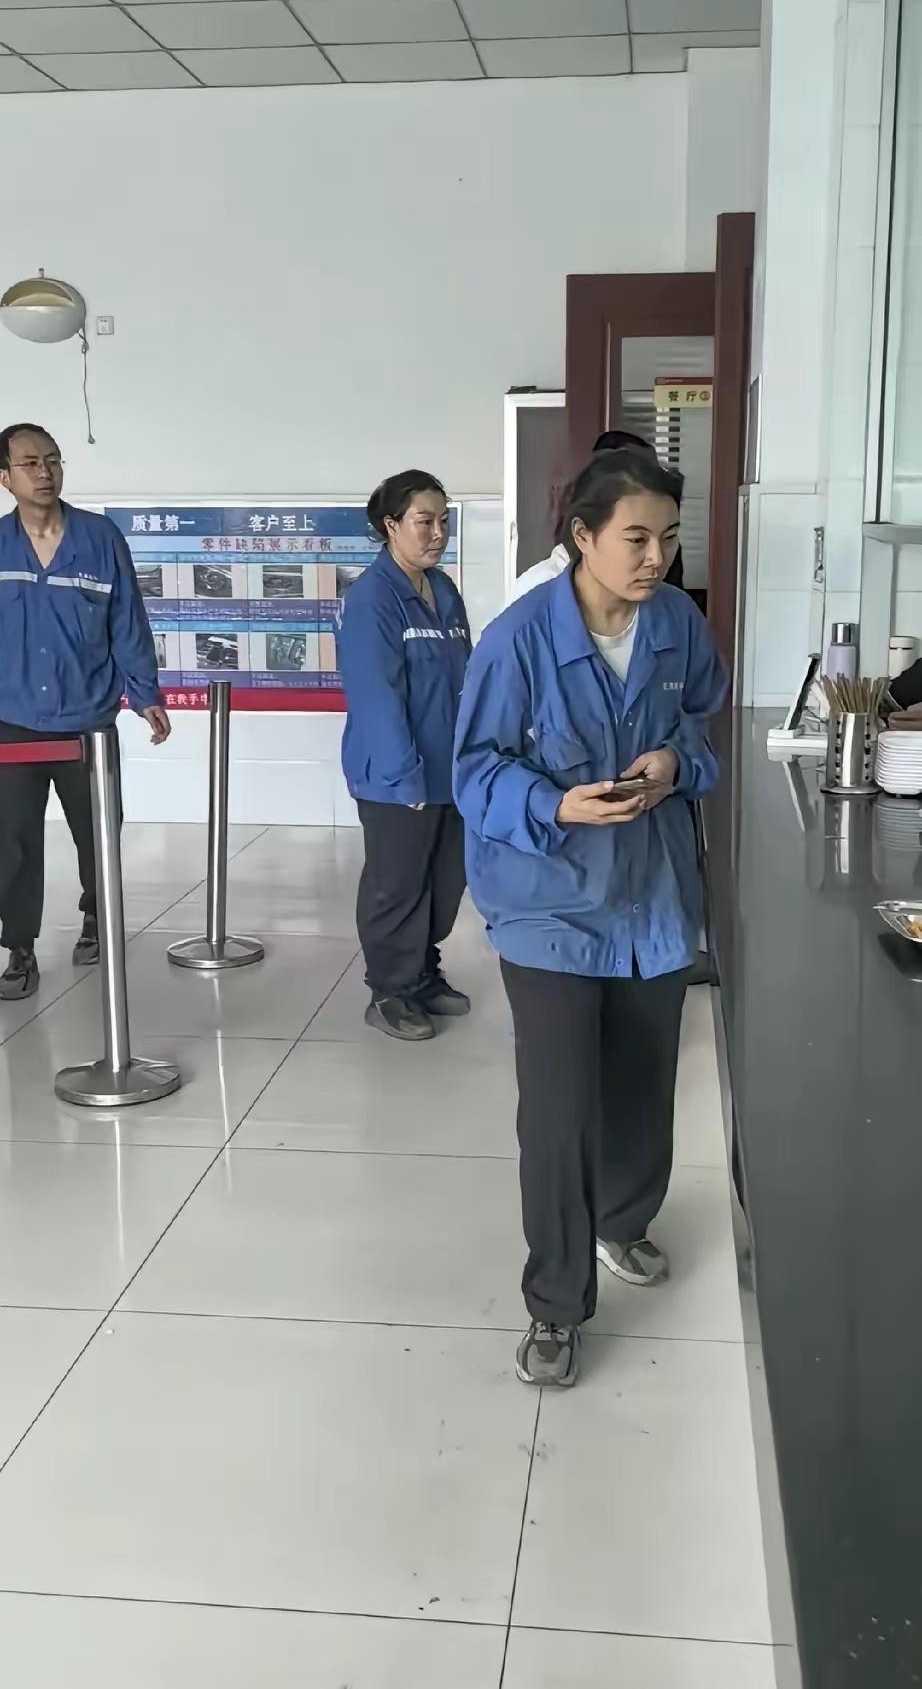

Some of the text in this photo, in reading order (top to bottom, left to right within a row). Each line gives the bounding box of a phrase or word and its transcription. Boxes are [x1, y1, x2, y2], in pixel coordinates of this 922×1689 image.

[131, 514, 195, 532] 质量第一
[249, 514, 315, 532] 客户至上
[201, 537, 332, 551] 零件缺陷展示看板
